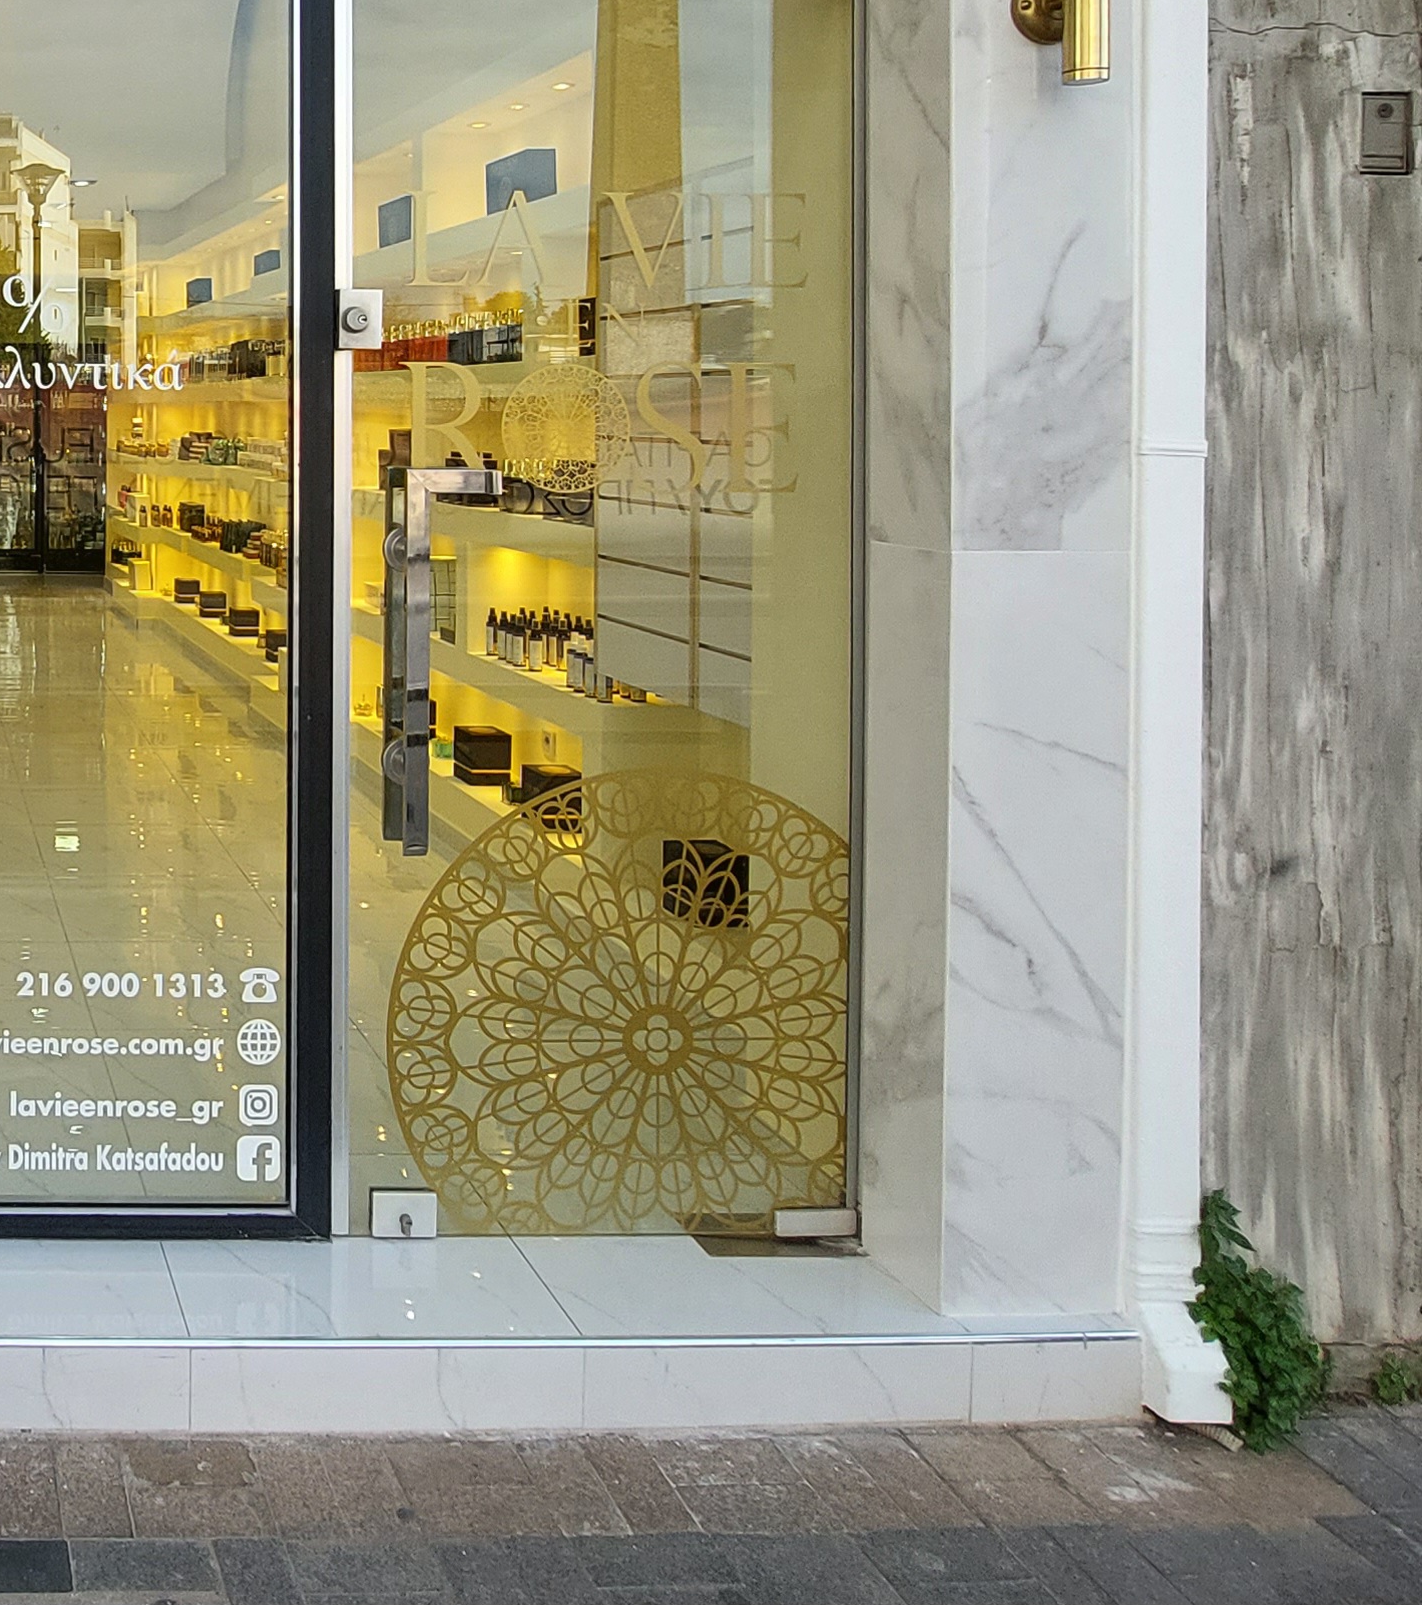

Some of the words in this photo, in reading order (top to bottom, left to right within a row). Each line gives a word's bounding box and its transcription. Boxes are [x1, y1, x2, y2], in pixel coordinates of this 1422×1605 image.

[405, 189, 549, 288] LA
[601, 190, 810, 290] VIE
[567, 297, 646, 348] EN
[16, 972, 73, 998] 216
[82, 972, 140, 998] 900
[153, 972, 227, 998] 1313
[9, 1091, 224, 1123] lavieenrose_gr
[7, 1142, 89, 1172] Dimitra
[96, 1142, 225, 1173] Katsafadou
